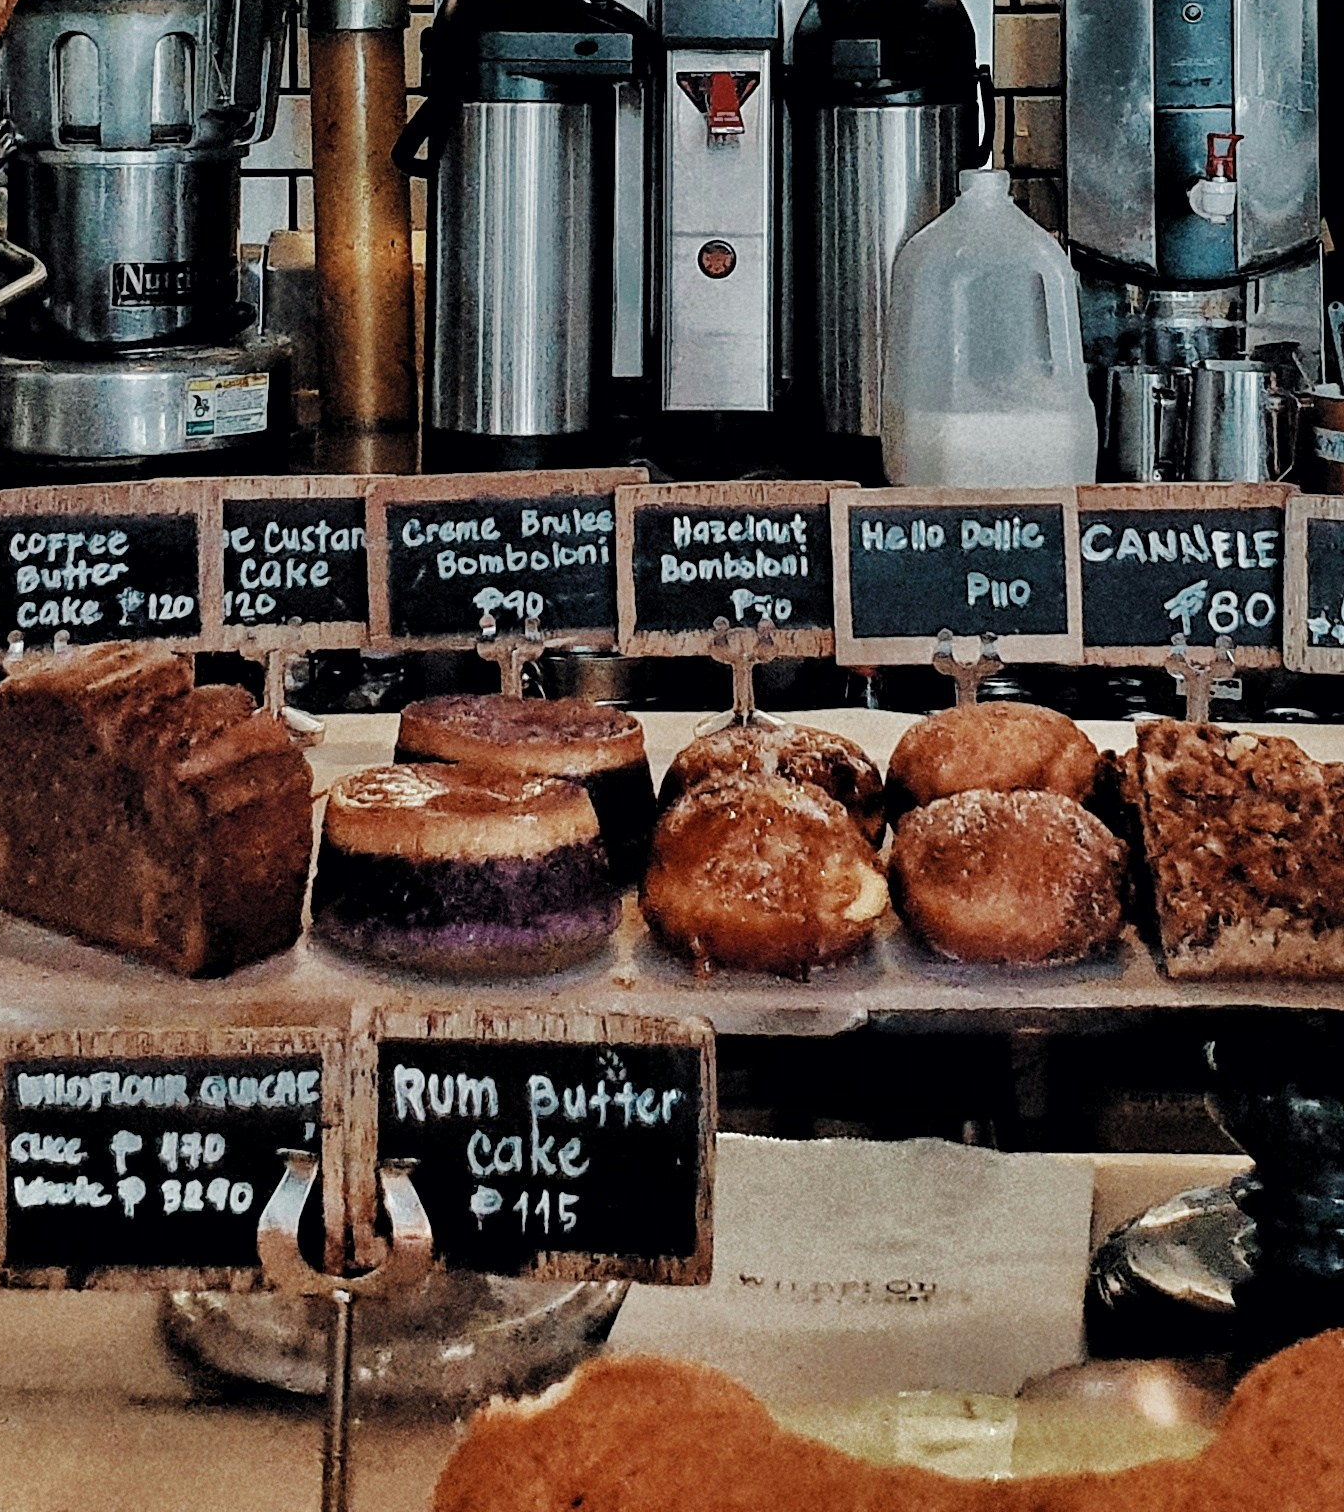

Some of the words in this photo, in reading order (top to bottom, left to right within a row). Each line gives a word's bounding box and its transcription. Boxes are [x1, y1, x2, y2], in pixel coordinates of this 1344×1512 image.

[672, 512, 808, 550] Hazelnut
[861, 518, 946, 553] Hello
[960, 515, 1046, 552] Dollie
[1080, 522, 1280, 569] CANNELE
[16, 560, 130, 596] Butter
[435, 537, 611, 581] Bomboloni
[660, 544, 809, 585] Bomboloni
[393, 1063, 500, 1124] Rum
[526, 1073, 684, 1128] Butter
